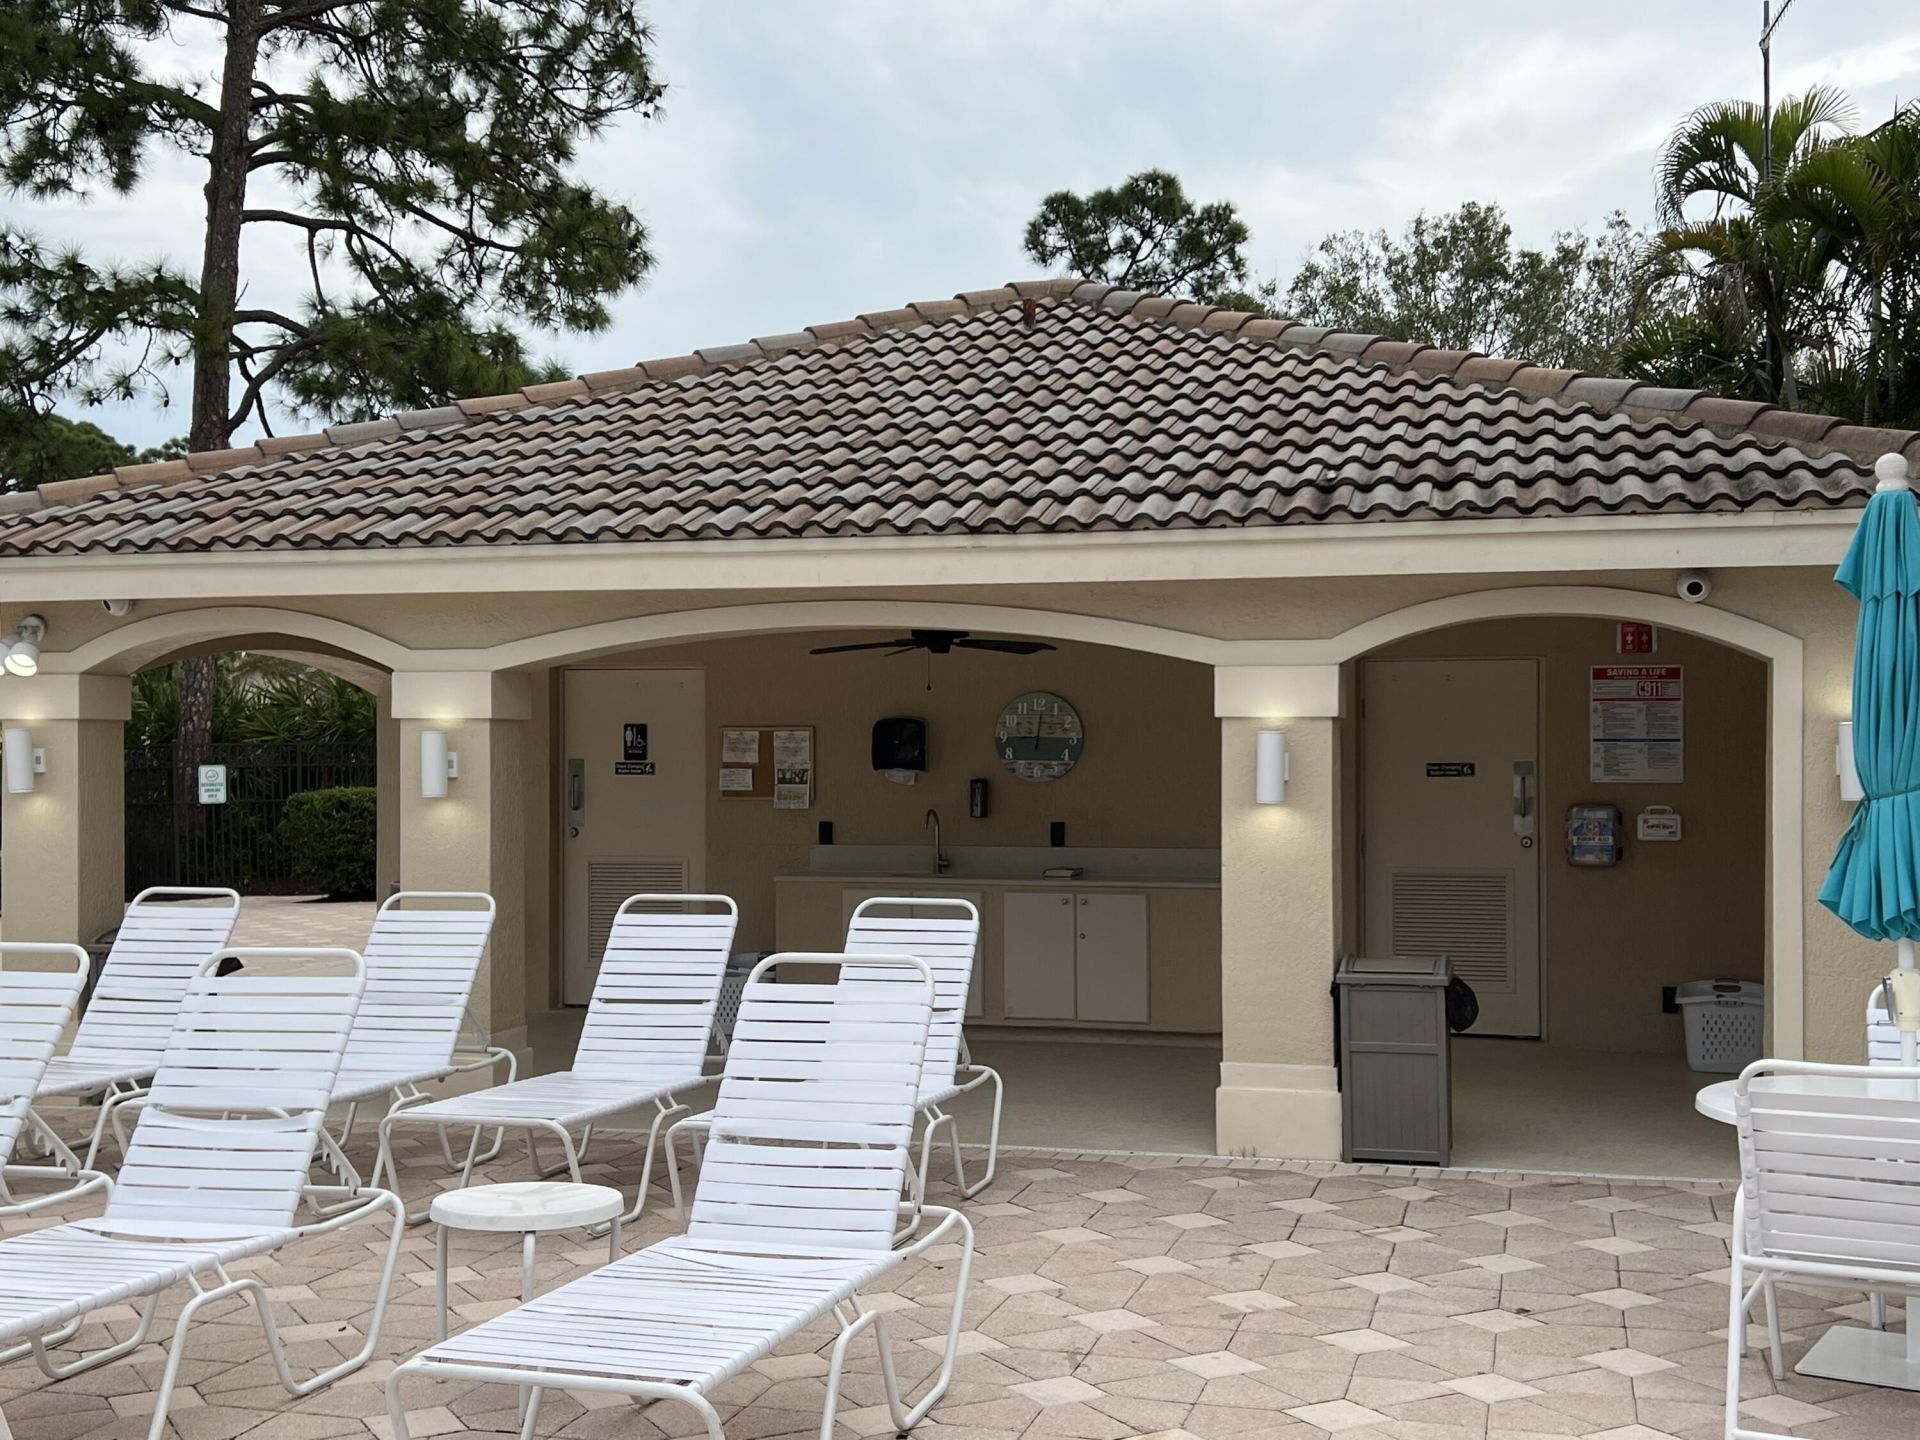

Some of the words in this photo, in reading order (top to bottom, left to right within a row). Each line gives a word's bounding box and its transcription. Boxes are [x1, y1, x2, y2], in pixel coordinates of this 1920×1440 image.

[1606, 668, 1639, 676] SAVING
[1641, 668, 1647, 676] A
[1649, 668, 1667, 676] LIFE
[1017, 702, 1028, 715] 11
[1032, 697, 1046, 711] 12
[1053, 703, 1058, 715] 1
[1005, 714, 1018, 727] 10
[1063, 715, 1072, 728] 2
[999, 730, 1008, 743] 9
[1004, 746, 1013, 760] 8
[1060, 747, 1069, 761] 4
[1033, 765, 1041, 778] 6
